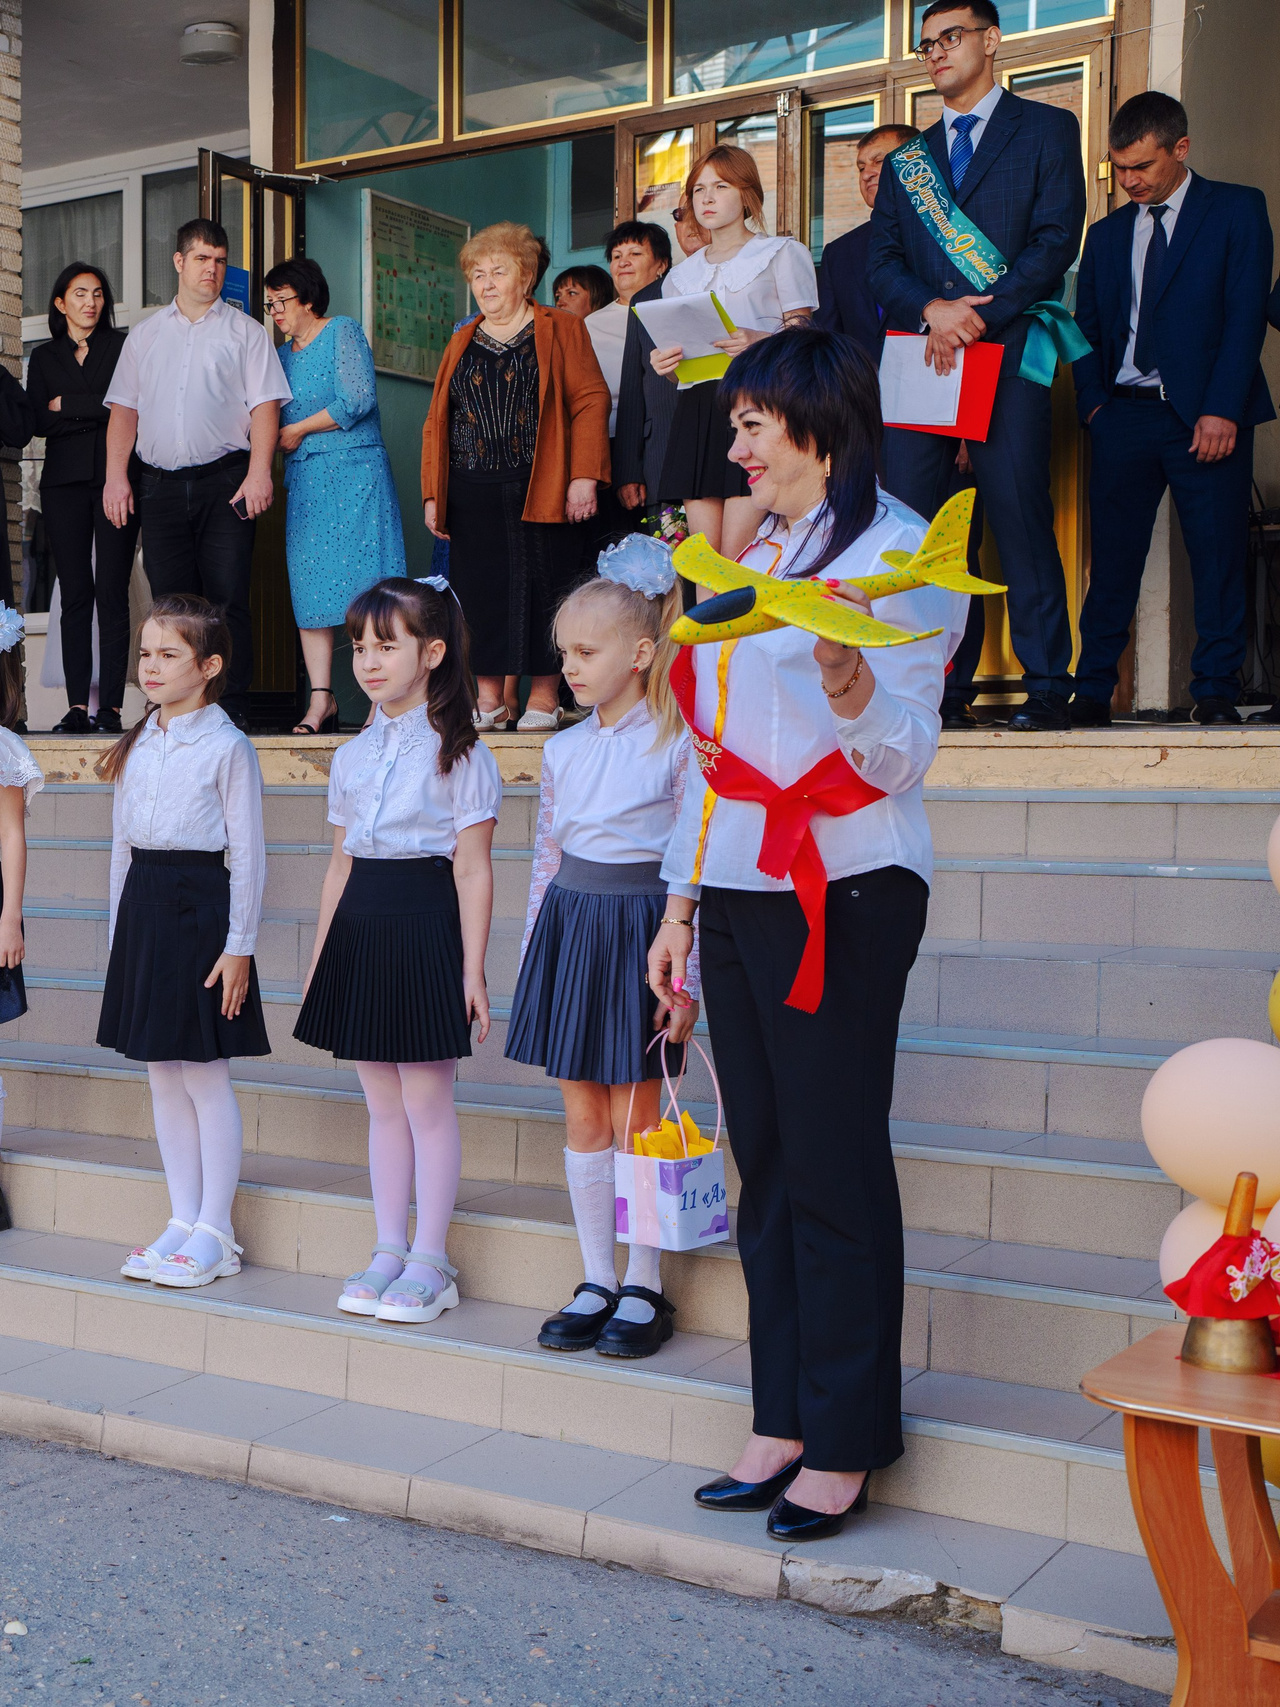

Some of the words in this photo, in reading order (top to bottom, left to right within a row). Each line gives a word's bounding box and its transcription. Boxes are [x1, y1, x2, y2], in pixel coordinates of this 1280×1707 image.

[899, 159, 957, 239] Выпускник
[945, 233, 976, 254] 9
[963, 249, 1000, 285] класс
[679, 1188, 697, 1212] 11
[702, 1182, 726, 1209] «А»
